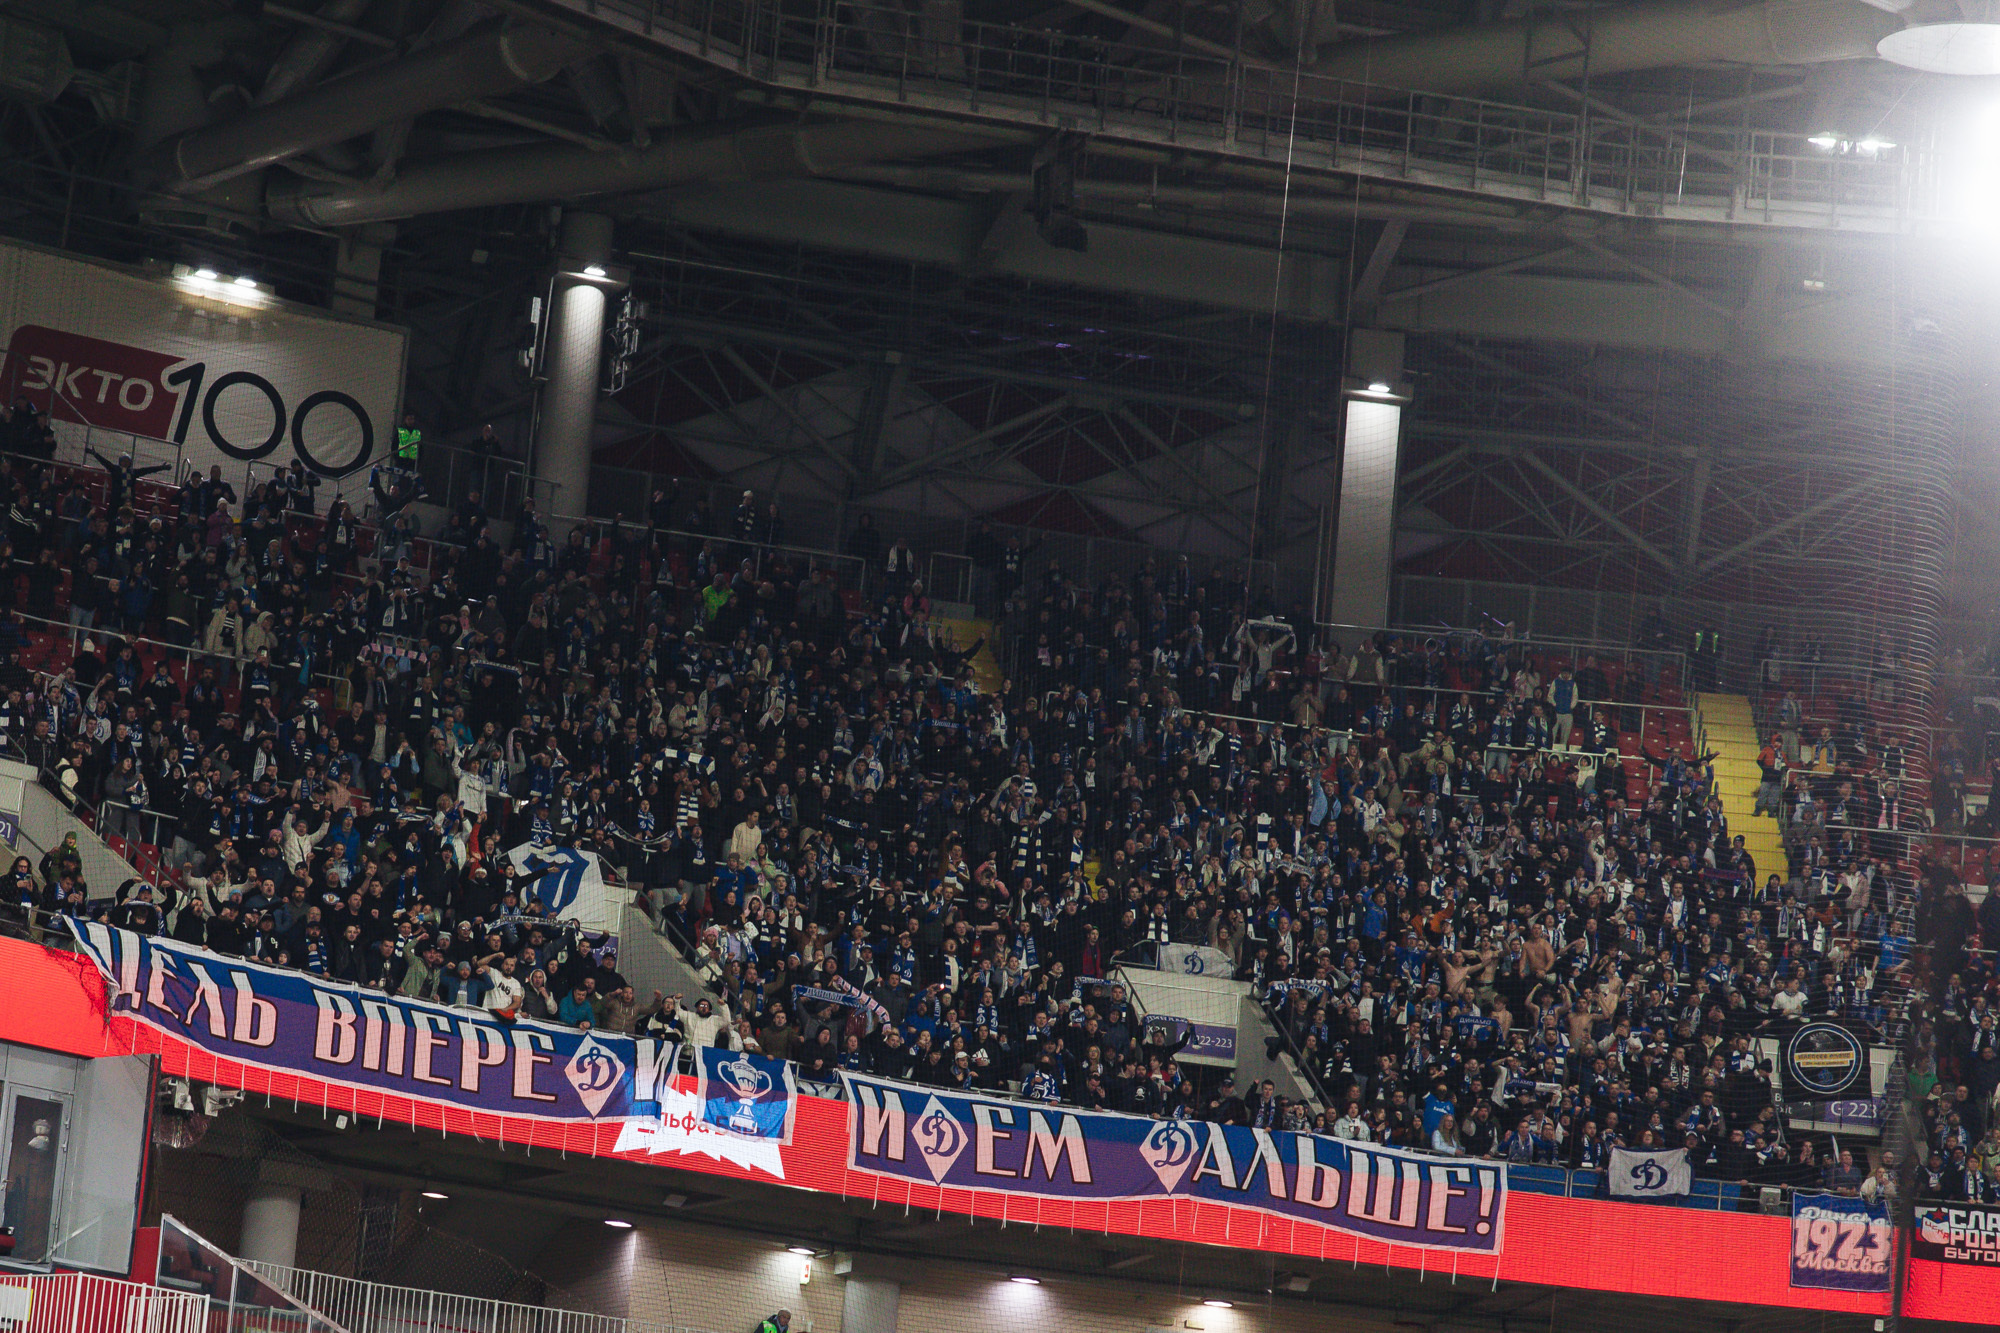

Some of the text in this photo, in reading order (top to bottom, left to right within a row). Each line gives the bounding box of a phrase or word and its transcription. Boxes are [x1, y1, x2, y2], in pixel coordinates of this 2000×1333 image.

[22, 355, 374, 477] ЭКТО 100
[1459, 1017, 1492, 1025] ДИНАМО
[1795, 1217, 1892, 1262] 1923
[1796, 1251, 1890, 1274] Москва
